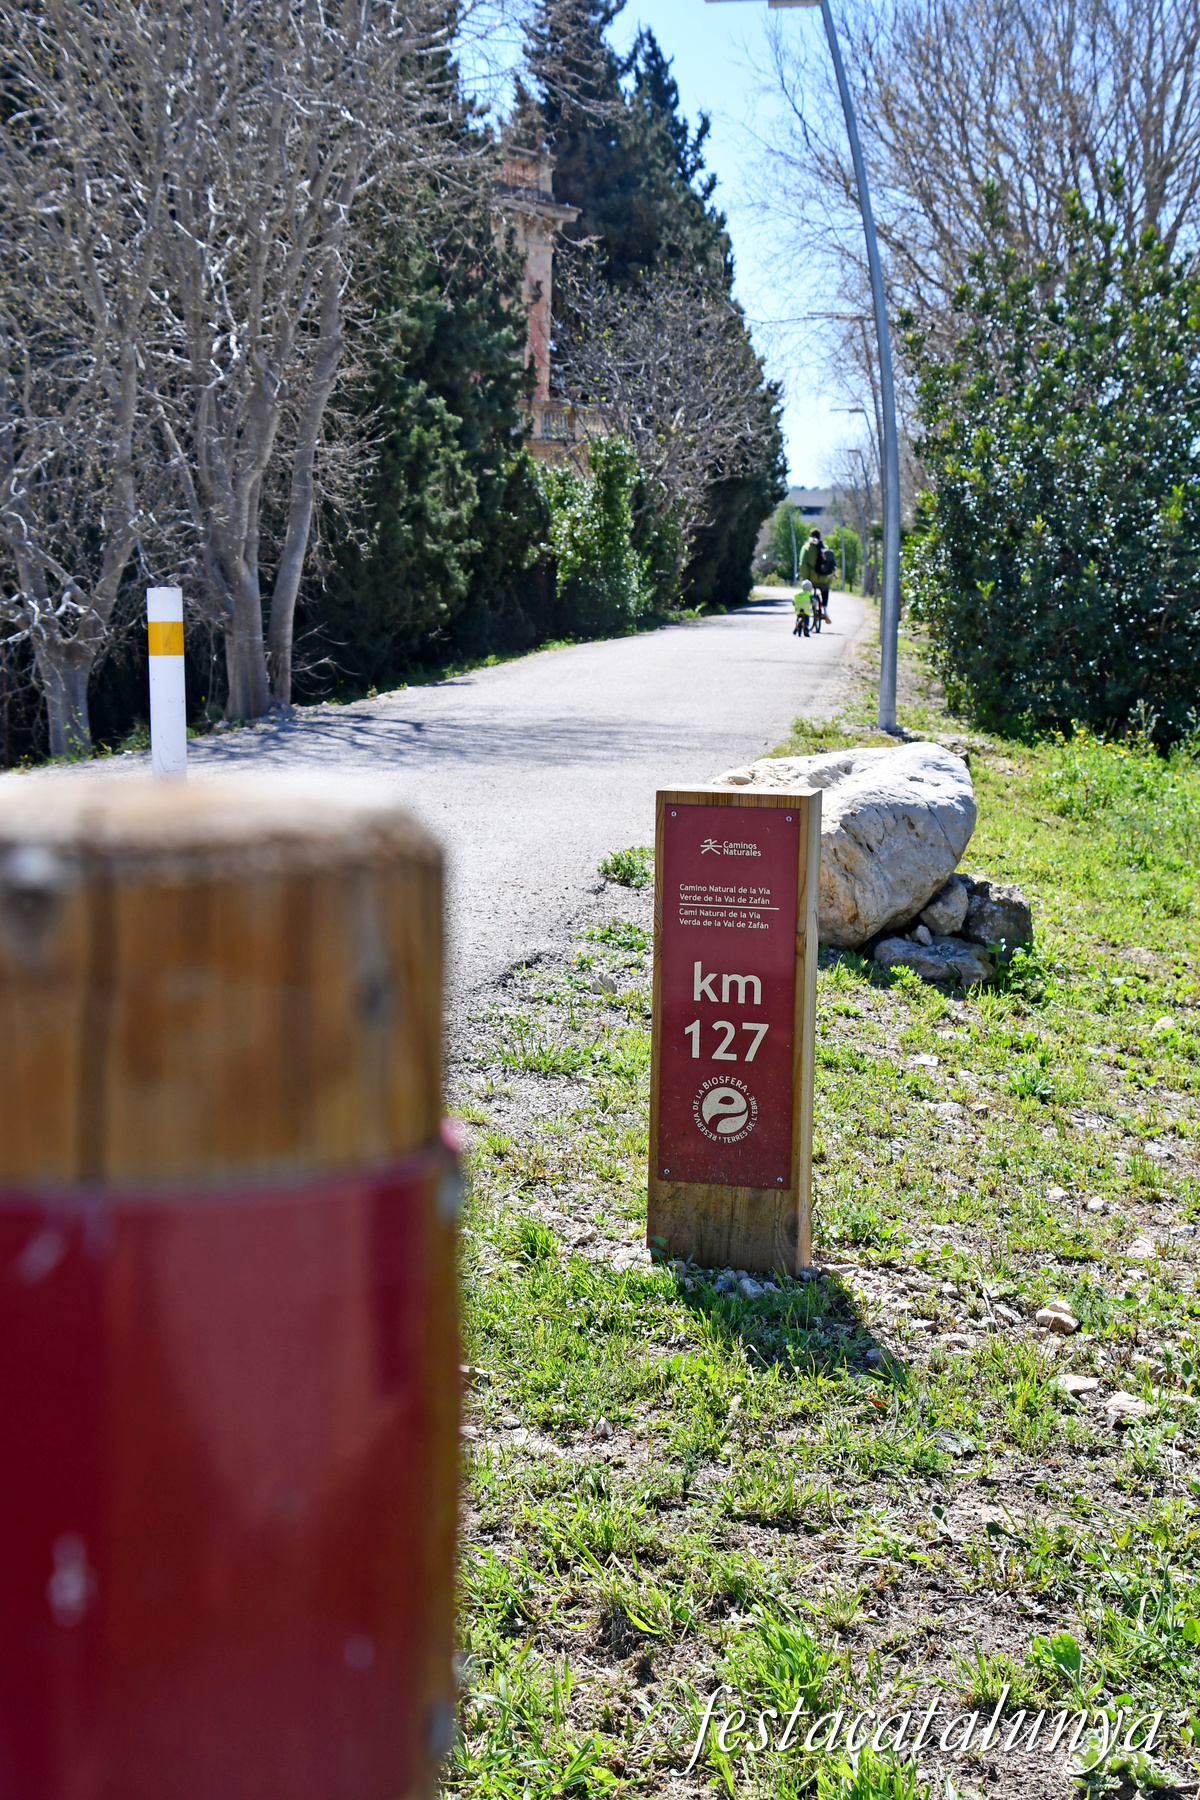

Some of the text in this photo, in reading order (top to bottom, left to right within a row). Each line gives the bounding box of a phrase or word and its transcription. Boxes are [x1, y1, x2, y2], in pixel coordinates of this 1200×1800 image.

[723, 841, 757, 849] Caminos
[723, 848, 762, 857] Naturales
[679, 884, 707, 892] Camino
[709, 885, 736, 893] Natural
[738, 886, 748, 894] de
[680, 893, 702, 901] Verde
[737, 896, 747, 904] de
[749, 896, 770, 905] Zafán
[700, 909, 727, 917] Natural
[679, 918, 701, 926] Verda
[702, 919, 712, 927] de
[723, 920, 735, 928] Val
[748, 921, 769, 929] Zafán
[693, 961, 762, 1005] km
[684, 1019, 770, 1062] 127
[692, 1075, 748, 1141] RESERVA DE LA BIOSFERA
[722, 1130, 748, 1144] TERRES
[746, 1121, 756, 1132] DE
